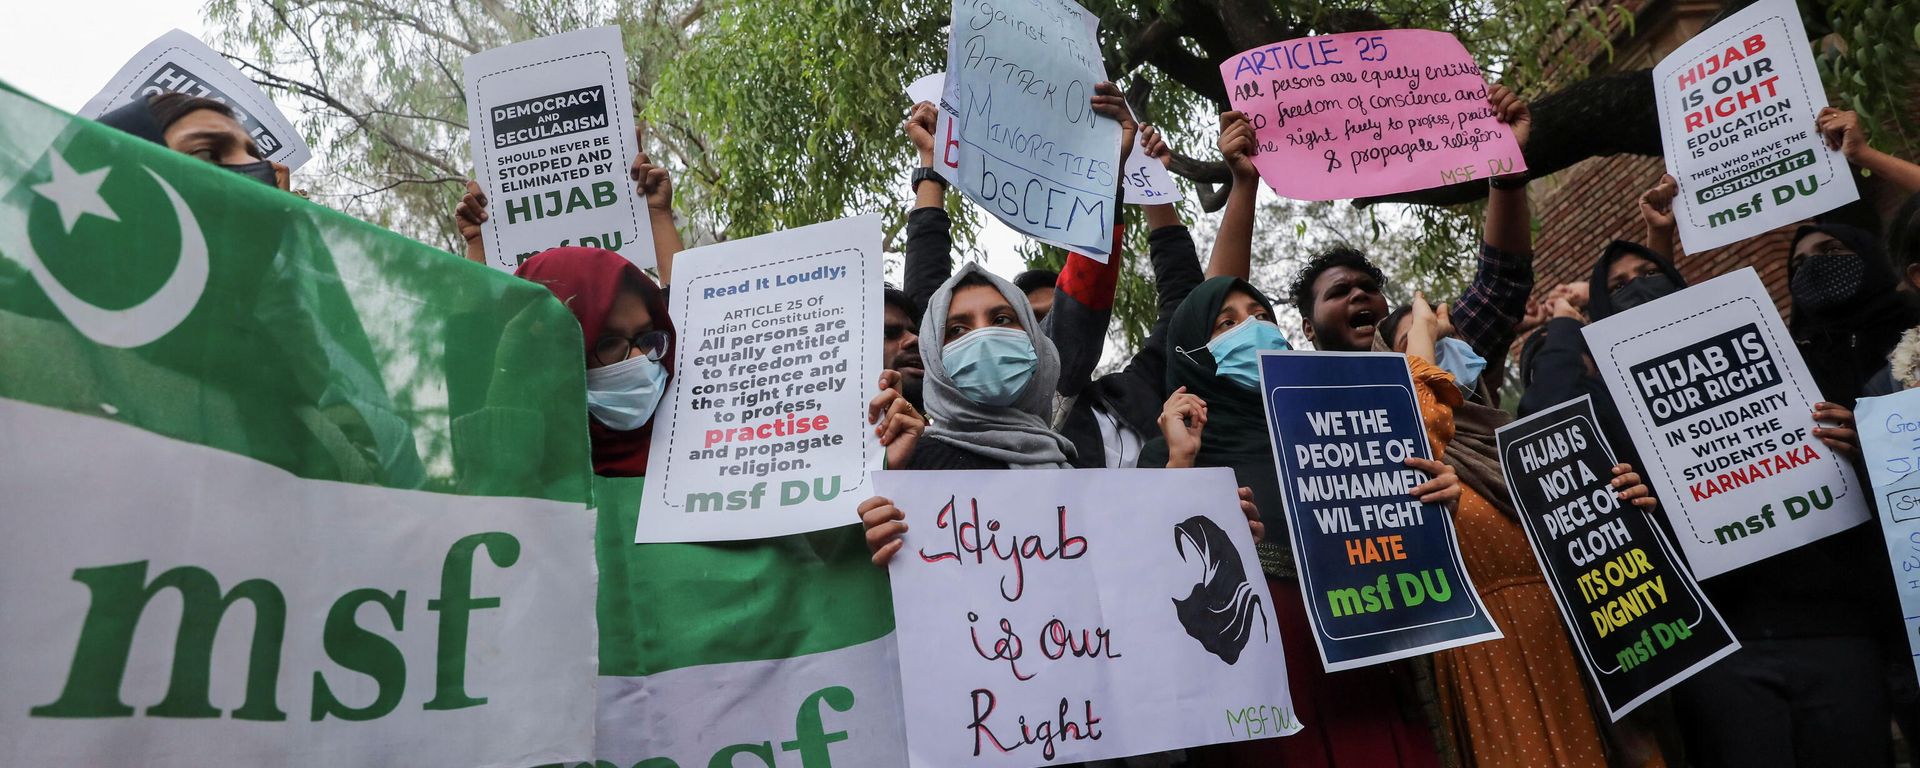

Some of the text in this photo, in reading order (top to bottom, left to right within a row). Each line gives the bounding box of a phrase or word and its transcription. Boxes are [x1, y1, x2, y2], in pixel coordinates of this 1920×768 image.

[963, 0, 1047, 44] gainst
[964, 35, 1057, 109] ATTACK
[1235, 36, 1387, 79] ARTICLE 25
[1678, 34, 1766, 91] HIJAB
[1235, 61, 1481, 101] All persons are equally entitled
[1682, 57, 1774, 112] IS OUR
[495, 90, 600, 122] DEMOCRACY
[538, 113, 560, 124] AND
[1278, 98, 1342, 128] freedom
[1350, 94, 1366, 116] of
[1455, 84, 1487, 100] and
[1685, 75, 1779, 133] RIGHT
[1687, 99, 1791, 149] EDUCATION
[496, 114, 605, 147] SECULARISM
[498, 137, 609, 166] SHOULD NEVER BE
[964, 83, 1113, 187] MINORITIES
[1254, 138, 1279, 157] he
[1287, 128, 1338, 149] right
[1344, 116, 1382, 140] freely
[1388, 116, 1402, 130] to
[1409, 113, 1454, 134] profess,
[1324, 128, 1502, 173] & propagate religion
[1692, 113, 1793, 159] IS OUR RIGHT,
[499, 149, 612, 180] STOPPED AND
[1440, 157, 1513, 184] MSF DU
[1690, 131, 1807, 181] THEN WHO HAVE THE
[1702, 154, 1809, 200] OBSTRUCT IT?
[1712, 148, 1791, 183] AUTHORITY TO
[502, 163, 613, 193] ELIMINATED BY
[505, 181, 618, 224] HIJAB
[1708, 174, 1818, 228] msf DU
[704, 265, 846, 299] Read It Loudly;
[704, 306, 844, 336] Indian Constitution:
[723, 296, 824, 321] ARTICLE 25 Of
[694, 330, 849, 367] equally entitled
[699, 319, 846, 352] All persons are
[692, 360, 847, 395] conscience and
[702, 346, 839, 380] to freedom of
[1637, 332, 1765, 398] HIJAB IS
[692, 376, 846, 410] the right freely
[714, 399, 821, 423] to profess,
[1652, 360, 1775, 419] OUR RIGHT
[705, 413, 829, 448] practise
[1306, 409, 1392, 436] WE THE
[1665, 391, 1790, 447] IN SOLIDARITY
[1691, 418, 1782, 458] WITH THE
[689, 433, 843, 460] and propagate
[720, 458, 811, 477] religion.
[1295, 439, 1415, 469] PEOPLE OF
[1519, 424, 1587, 474] HIJAB IS
[1683, 428, 1807, 481] STUDENTS OF
[684, 476, 840, 513] msf DU
[1538, 460, 1598, 502] NOT A
[1689, 444, 1820, 502] KARNATAKA
[1313, 501, 1424, 534] WIL FIGHT
[1543, 483, 1621, 540] PIECE OF
[1714, 485, 1834, 545] msf DU
[1345, 535, 1407, 566] HATE
[1567, 517, 1633, 567] CLOTH
[1327, 568, 1451, 618] msf DU
[1577, 548, 1654, 604] ITS OUR
[29, 532, 521, 722] msf
[1590, 576, 1668, 638] DIGNITY
[968, 612, 1121, 680] is Our
[1616, 629, 1658, 673] msf
[967, 687, 1103, 761] Right
